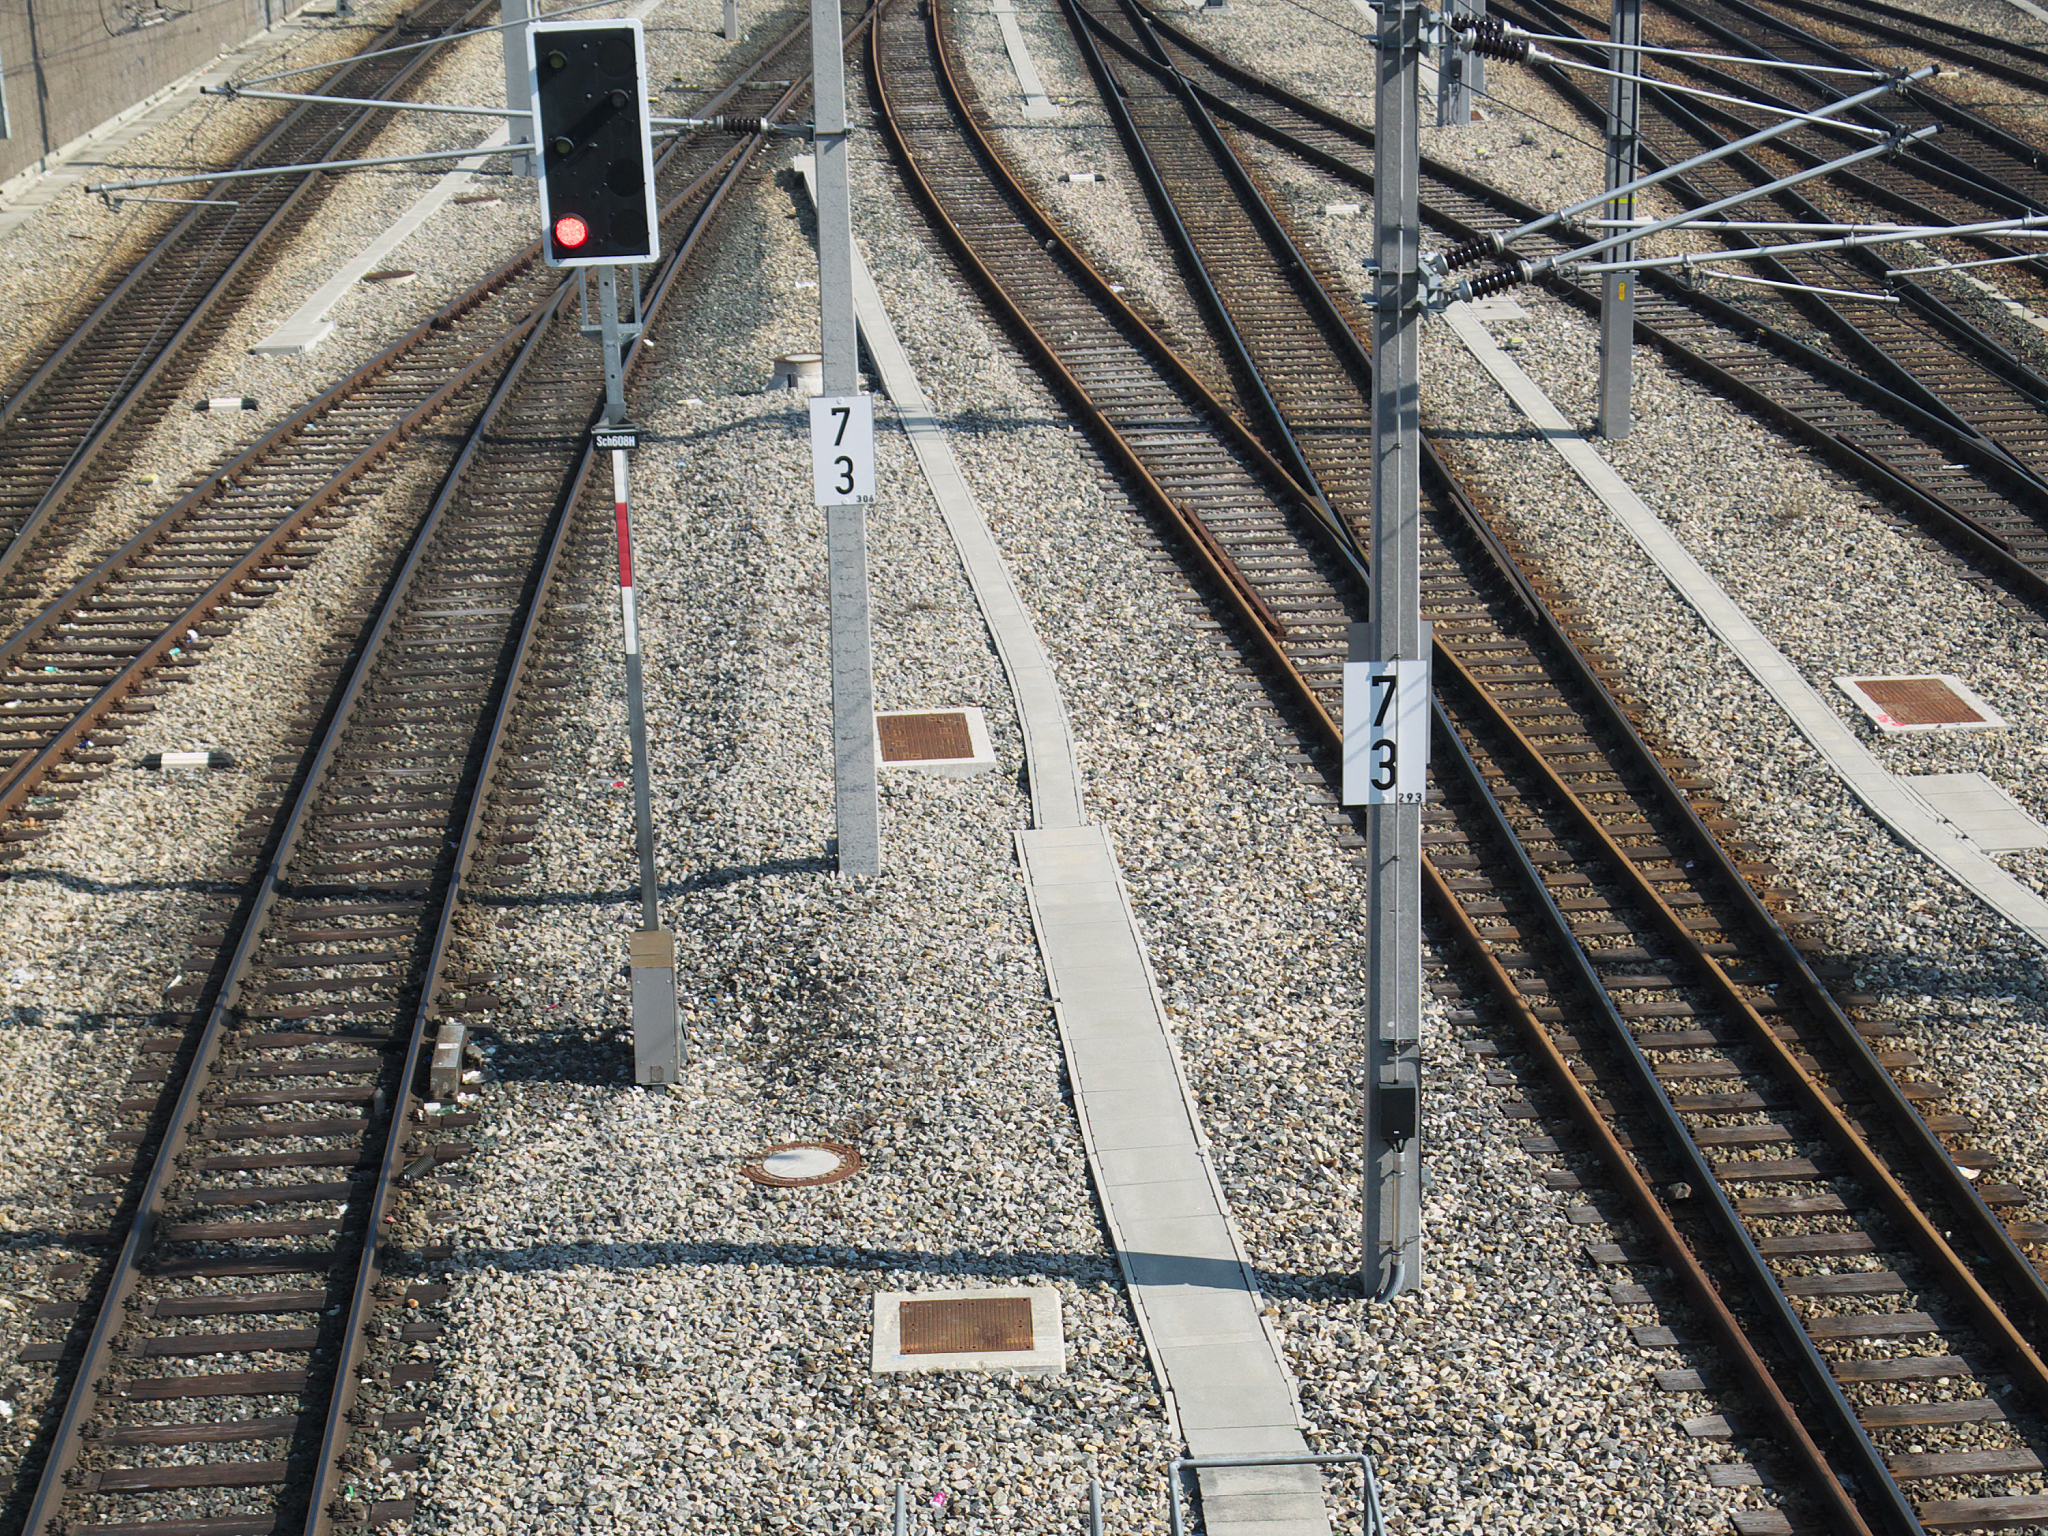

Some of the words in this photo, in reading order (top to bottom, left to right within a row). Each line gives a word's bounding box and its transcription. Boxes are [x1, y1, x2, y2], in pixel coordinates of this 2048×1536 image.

[831, 407, 851, 446] 7
[834, 455, 855, 495] 3
[856, 495, 874, 503] 306
[1372, 675, 1397, 727] 7
[1371, 739, 1397, 791] 3
[1399, 793, 1422, 803] 293
